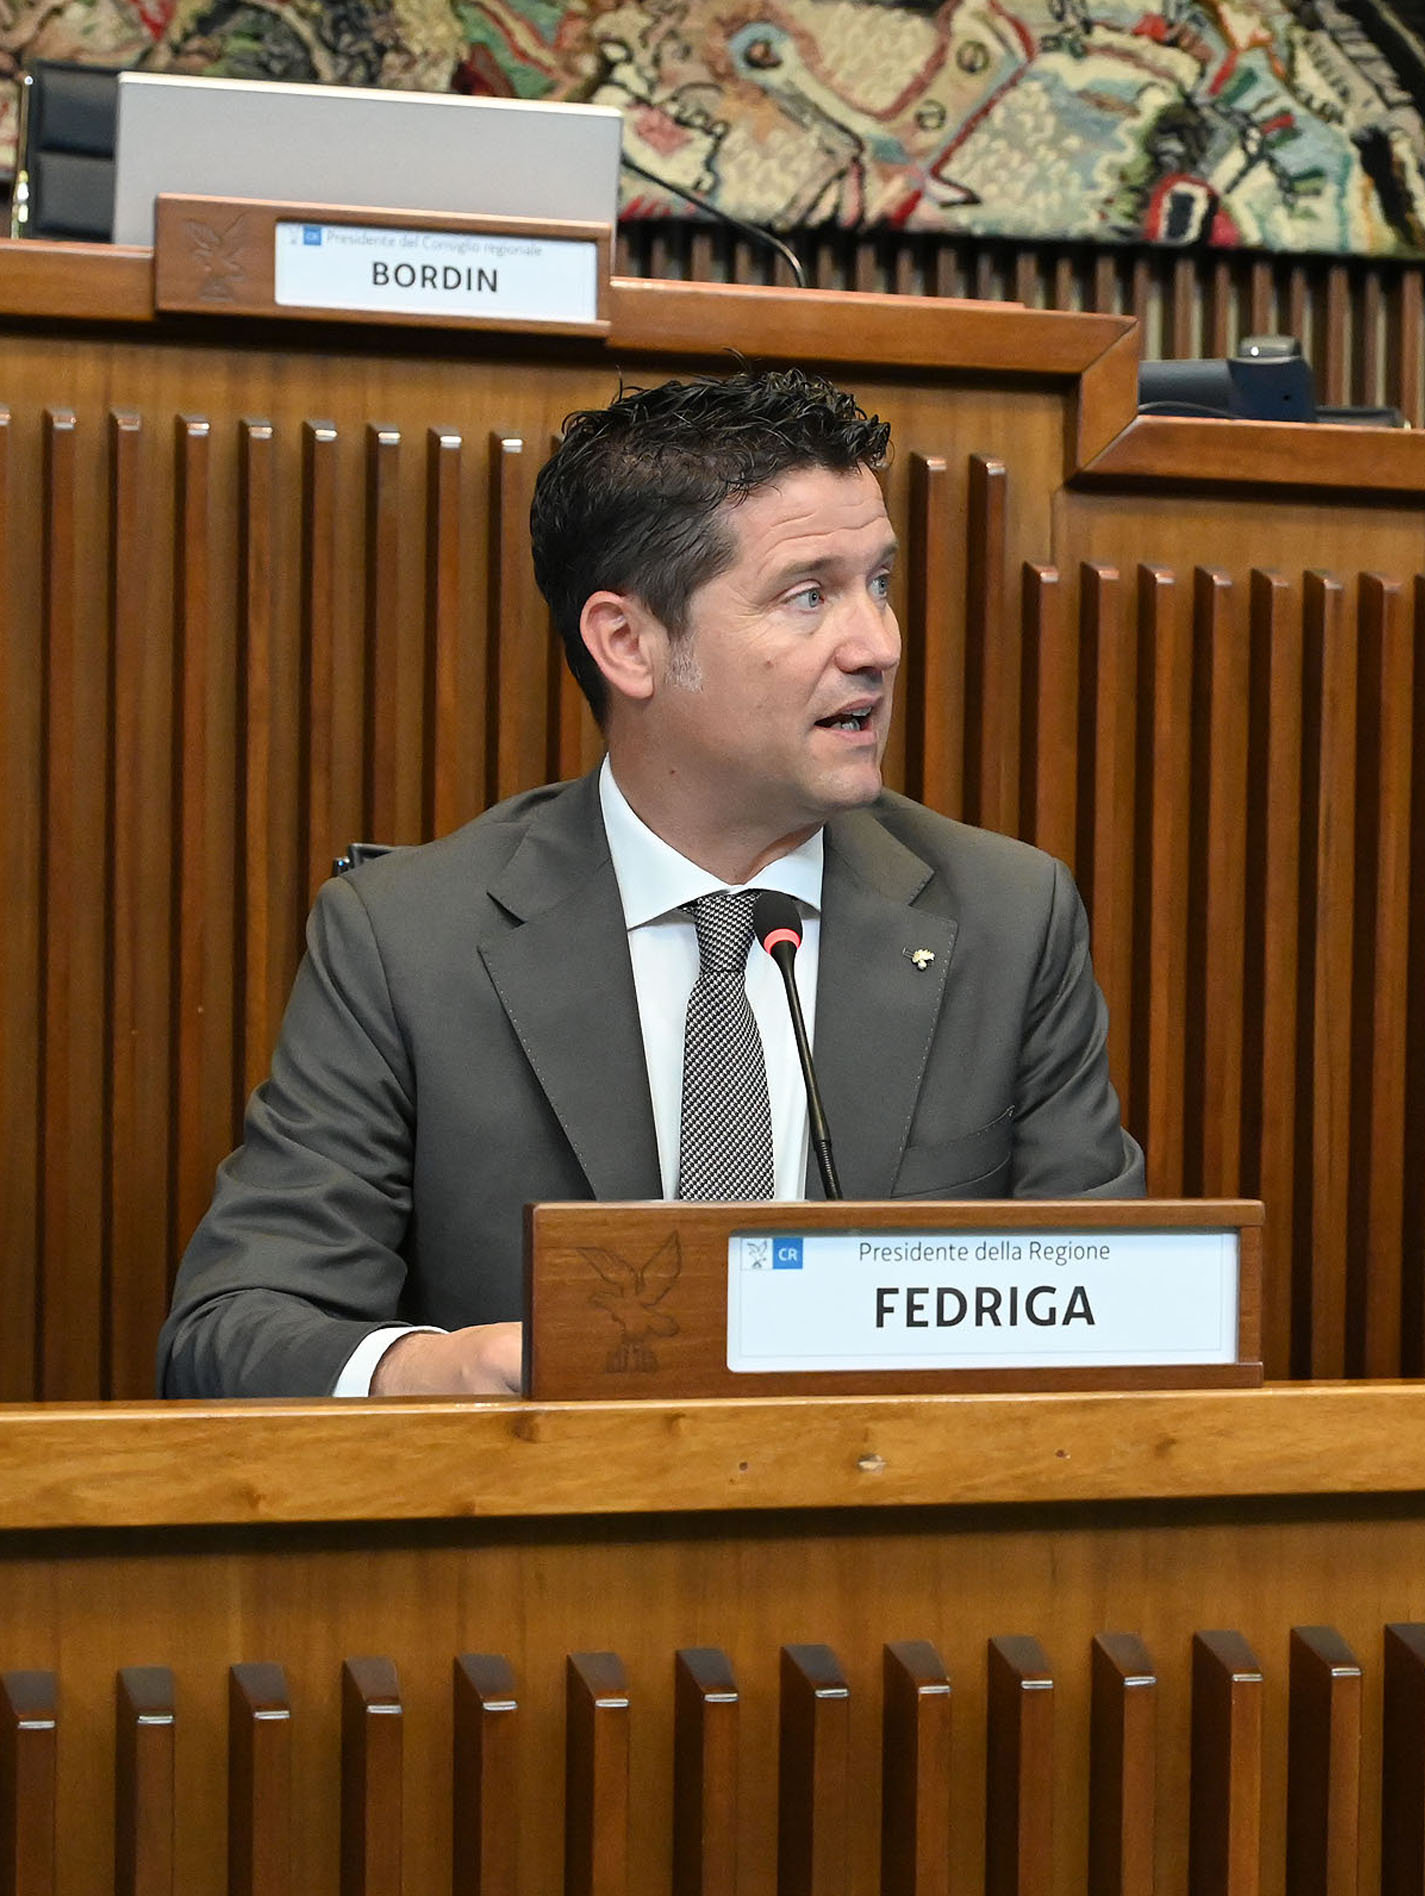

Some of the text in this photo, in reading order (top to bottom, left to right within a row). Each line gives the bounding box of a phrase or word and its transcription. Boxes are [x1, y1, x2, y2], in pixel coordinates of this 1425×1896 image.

[326, 230, 397, 247] Presidente
[400, 234, 418, 248] del
[371, 261, 499, 293] BORDIN
[778, 1247, 798, 1261] CR
[859, 1240, 1110, 1267] Presidente della Regione
[875, 1284, 1096, 1328] FEDRIGA
